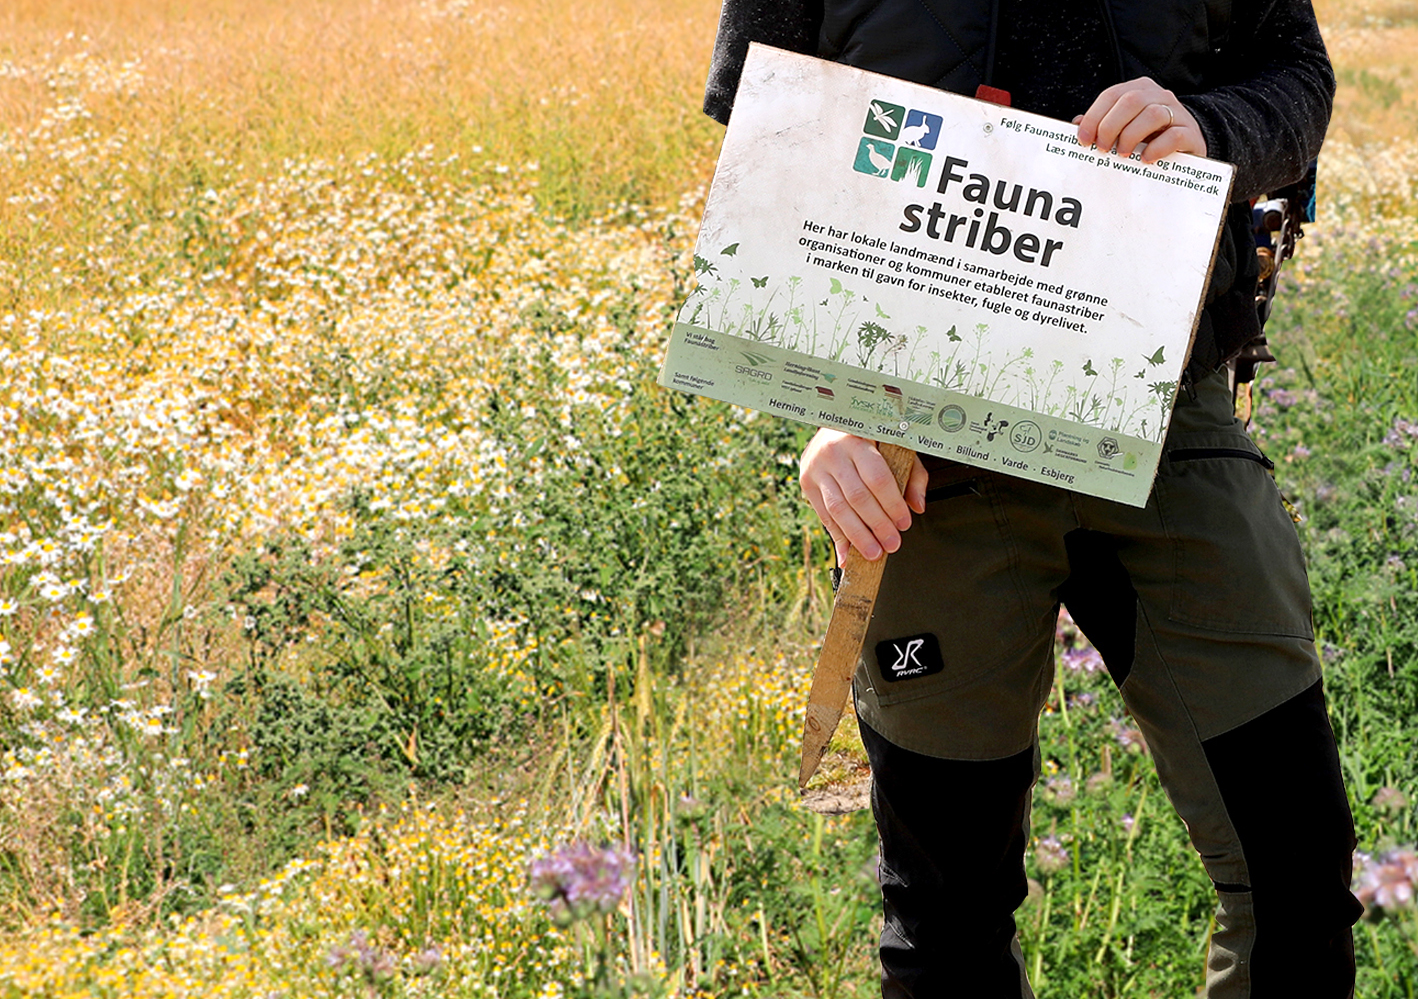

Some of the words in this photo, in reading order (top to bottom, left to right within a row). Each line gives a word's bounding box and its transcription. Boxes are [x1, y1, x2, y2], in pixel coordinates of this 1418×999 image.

[1001, 118, 1022, 133] Følg
[1156, 159, 1170, 170] og
[1172, 163, 1223, 183] Instagram
[1046, 143, 1066, 156] Læs
[1068, 151, 1095, 164] mere
[1097, 157, 1110, 168] på
[1113, 162, 1220, 196] www.faunastriber.dk
[937, 156, 1082, 228] Fauna
[803, 220, 825, 234] Her
[828, 226, 848, 240] har
[850, 232, 887, 250] lokale
[889, 242, 955, 267] landmænd
[957, 259, 962, 269] i
[963, 262, 1034, 287] samarbejde
[1036, 281, 1064, 295] med
[1065, 288, 1109, 307] grønne
[899, 202, 1064, 268] striber
[798, 237, 886, 266] organisationer
[888, 259, 903, 273] og
[906, 262, 971, 287] kommuner
[974, 281, 1029, 303] etableret
[1031, 293, 1105, 321] faunastriber
[806, 253, 811, 263] i
[813, 256, 858, 275] marken
[862, 268, 875, 279] til
[876, 273, 905, 287] gavn
[908, 278, 926, 292] for
[928, 283, 978, 307] insekter,
[982, 297, 1012, 314] fugle
[1014, 308, 1030, 321] og
[1032, 311, 1088, 334] dyrelivet.
[735, 365, 773, 381] SAGRO
[769, 398, 806, 416] Herning
[819, 411, 864, 429] Holstebro
[876, 425, 906, 439] Struer
[918, 435, 944, 450] Vejen
[956, 445, 990, 461] Billund
[1002, 457, 1029, 471] Varde
[1041, 466, 1075, 484] Esbjerg
[1014, 433, 1036, 446] SJD
